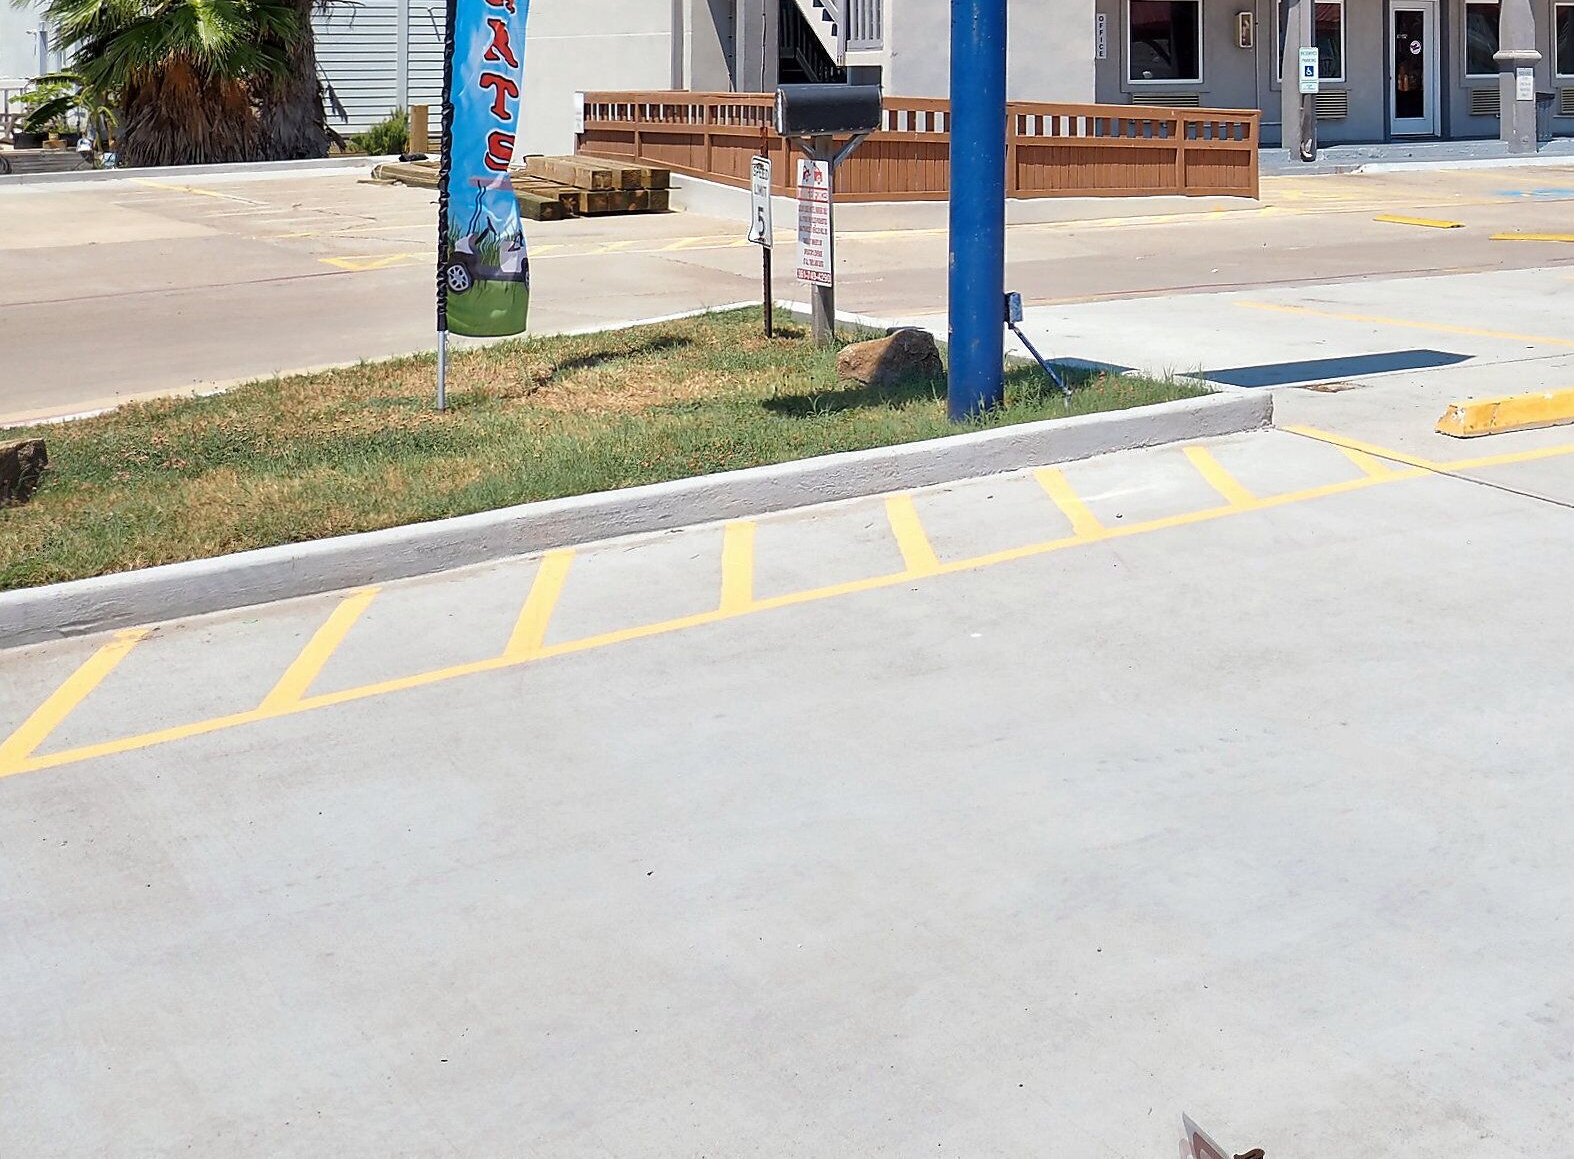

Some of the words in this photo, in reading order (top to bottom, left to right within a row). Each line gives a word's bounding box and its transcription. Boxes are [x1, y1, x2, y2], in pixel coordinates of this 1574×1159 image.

[752, 165, 769, 181] SPEED
[754, 184, 767, 198] LIMIT
[757, 206, 766, 237] 5
